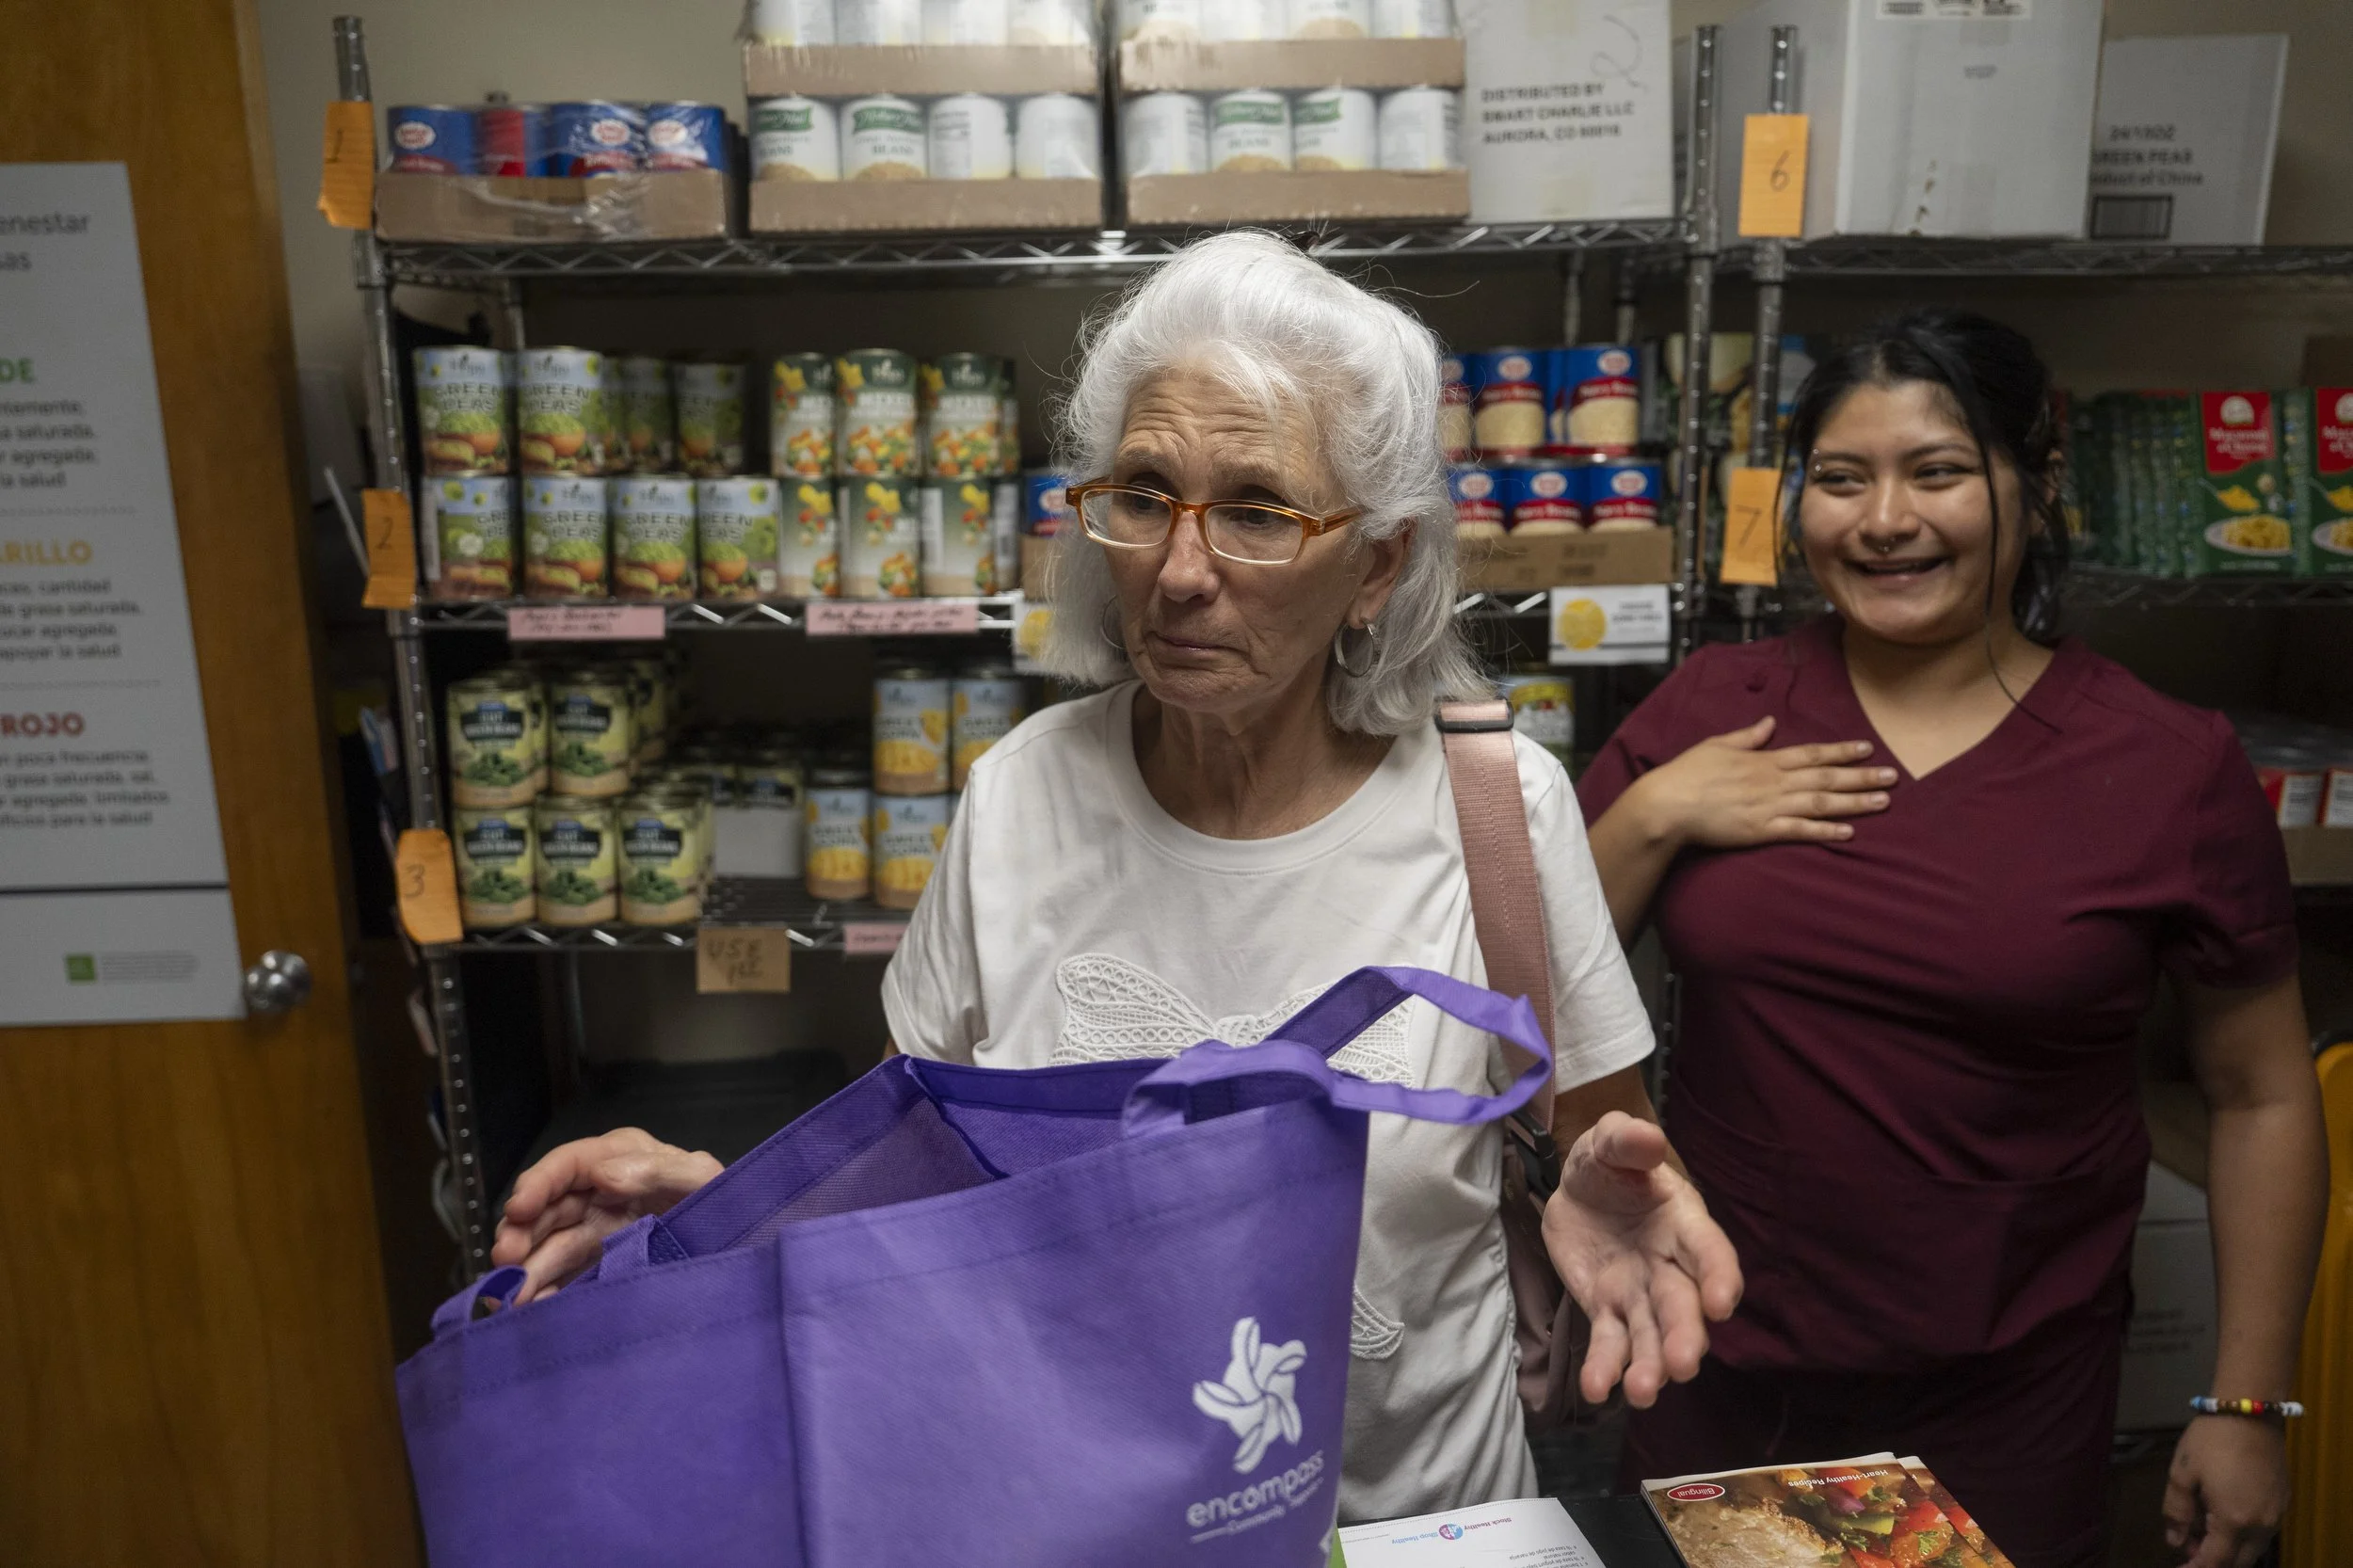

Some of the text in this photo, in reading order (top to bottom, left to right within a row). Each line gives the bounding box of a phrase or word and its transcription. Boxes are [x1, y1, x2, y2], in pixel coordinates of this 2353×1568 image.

[1481, 81, 1603, 102] DISTRIBUTED BY
[1605, 101, 1635, 116] LLC
[1769, 151, 1790, 192] 6
[374, 516, 395, 550] 2
[1735, 504, 1762, 550] 7
[0, 539, 93, 565] RILLO
[1, 712, 85, 737] ROJO
[405, 861, 426, 900] 3
[1186, 1450, 1324, 1528] encompass
[1788, 1468, 1888, 1487] Heart-Healthy Recipes
[1677, 1486, 1716, 1498] Bilingual
[1464, 1517, 1513, 1532] Stock Healthy
[1391, 1533, 1419, 1545] Healthy
[1418, 1531, 1439, 1542] Shop
